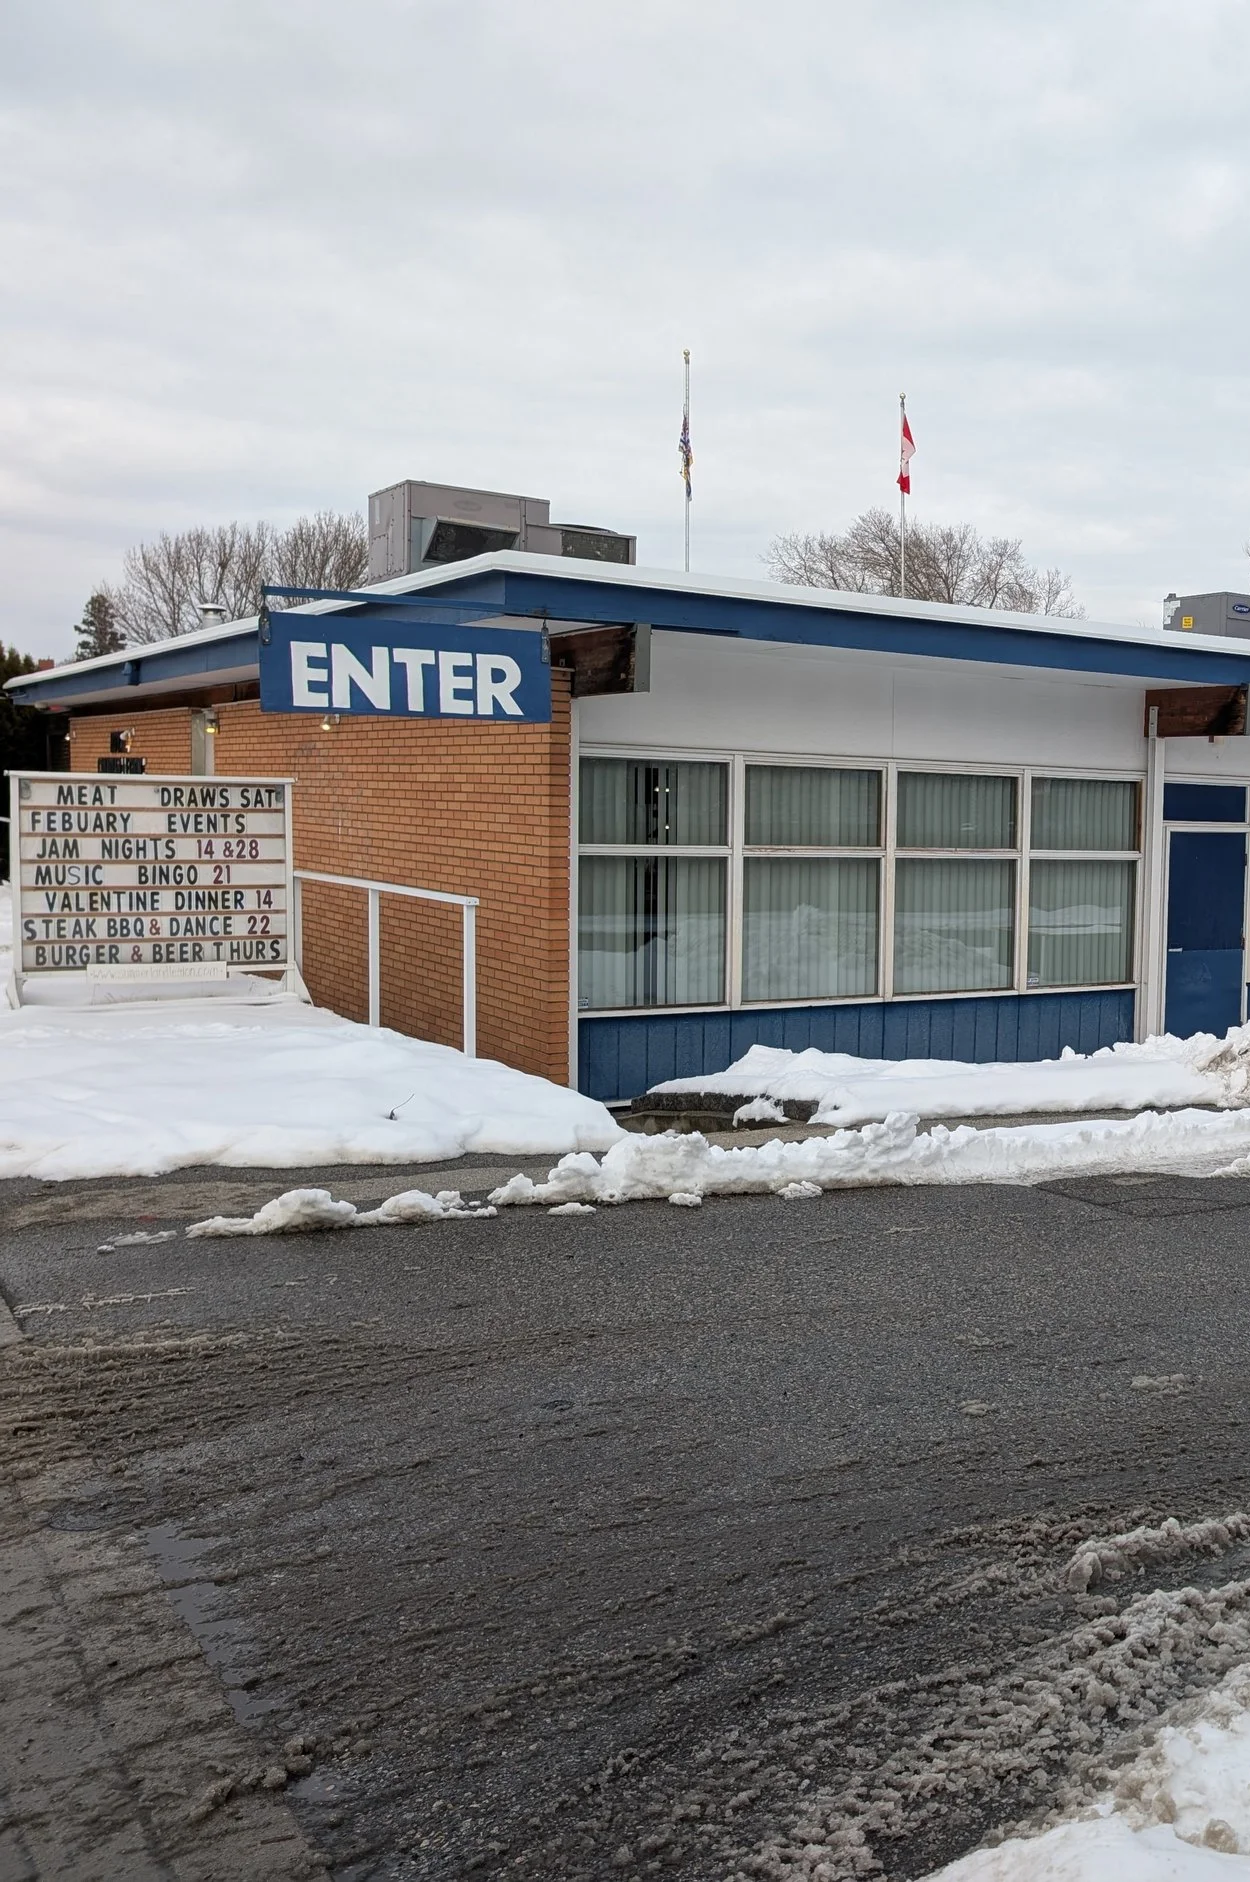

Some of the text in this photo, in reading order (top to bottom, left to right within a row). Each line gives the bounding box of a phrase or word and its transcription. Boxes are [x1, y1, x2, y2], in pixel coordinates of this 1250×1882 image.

[1234, 605, 1250, 613] Carrier
[290, 641, 524, 716] ENTER
[57, 785, 276, 808] MEAT DRAWS SAT
[31, 811, 246, 833] FEBUARY EVENTS
[37, 838, 79, 859] JAM
[102, 838, 175, 860] NIGHTS
[197, 839, 214, 858] 14
[35, 865, 231, 885] MUSIC BINGO 21
[46, 890, 273, 913] VALENTINE DINNER 14
[24, 918, 98, 941] STEAK
[107, 917, 144, 938] BBQ
[170, 916, 233, 936] DANCE
[248, 915, 270, 934] 22
[36, 945, 119, 966] BURGER
[131, 945, 142, 963] &
[153, 942, 203, 962] BEER
